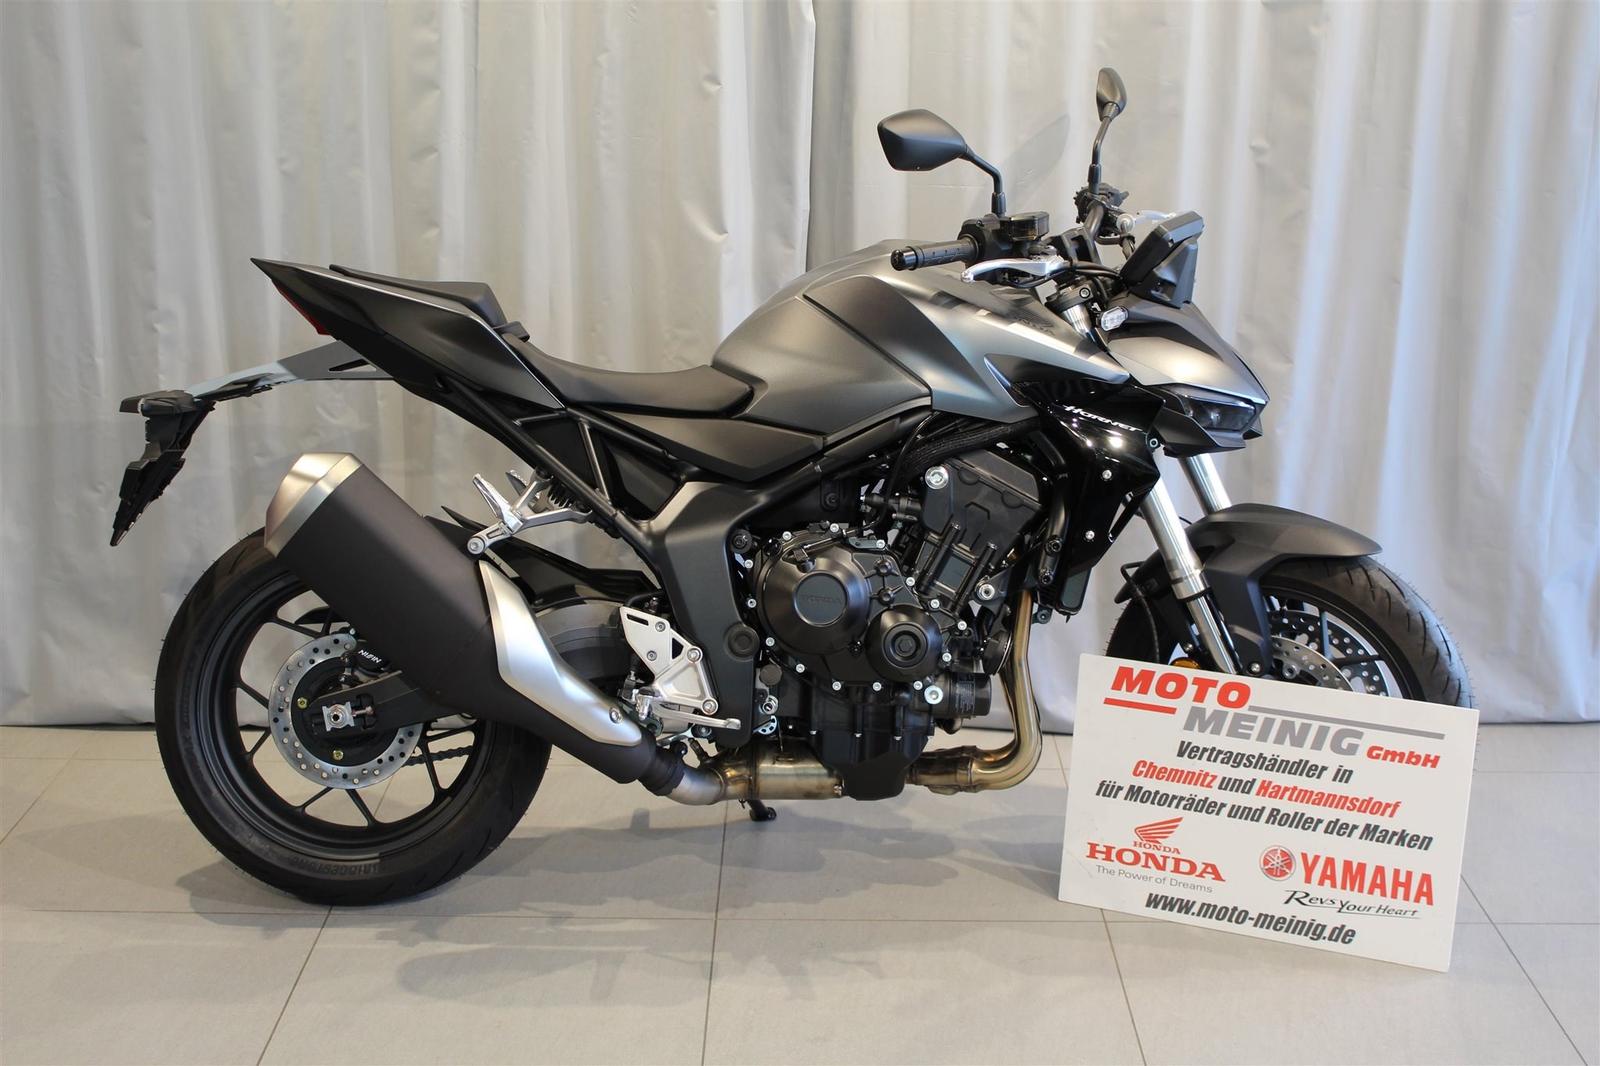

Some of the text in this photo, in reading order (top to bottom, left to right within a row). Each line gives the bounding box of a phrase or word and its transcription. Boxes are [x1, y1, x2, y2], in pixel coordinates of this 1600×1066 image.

[1111, 665, 1251, 709] MOTO
[1183, 705, 1440, 769] MEINIG GmbH
[1176, 741, 1354, 784] Vertragshändler in
[1132, 759, 1402, 818] Chemnitz und Hartmannsdorf
[1095, 780, 1434, 851] für Motorräder und Roller der Marken
[1086, 842, 1226, 882] HONDA
[1132, 840, 1182, 855] HONDA
[1096, 864, 1213, 893] The Power of Dreams
[1300, 852, 1434, 906] YAMAHA
[1145, 892, 1356, 944] www.moto-meinig.de
